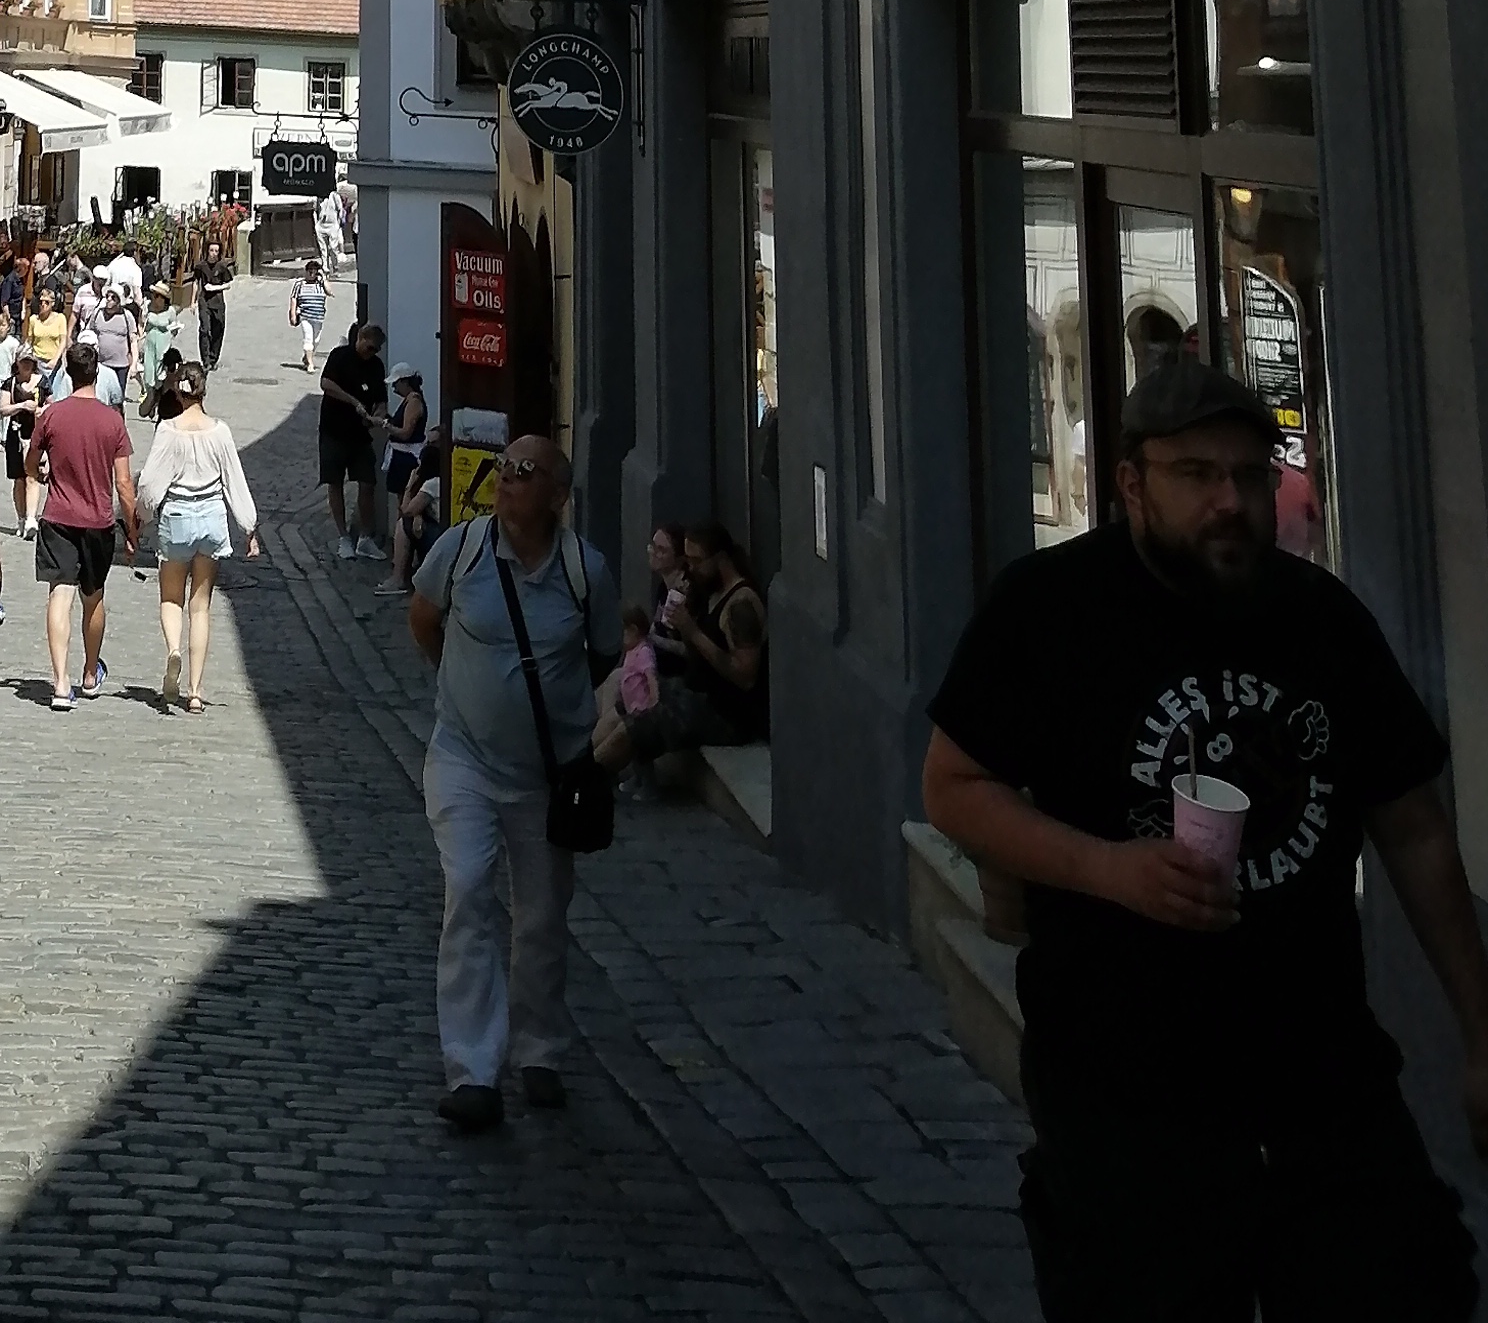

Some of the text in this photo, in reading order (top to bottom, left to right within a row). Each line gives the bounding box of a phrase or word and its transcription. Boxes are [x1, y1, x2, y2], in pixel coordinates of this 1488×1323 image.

[522, 41, 609, 74] LONGCHAMP
[273, 153, 326, 178] apm
[455, 251, 503, 275] Vacuum
[473, 290, 502, 309] Oils
[1131, 676, 1210, 788] ALLES
